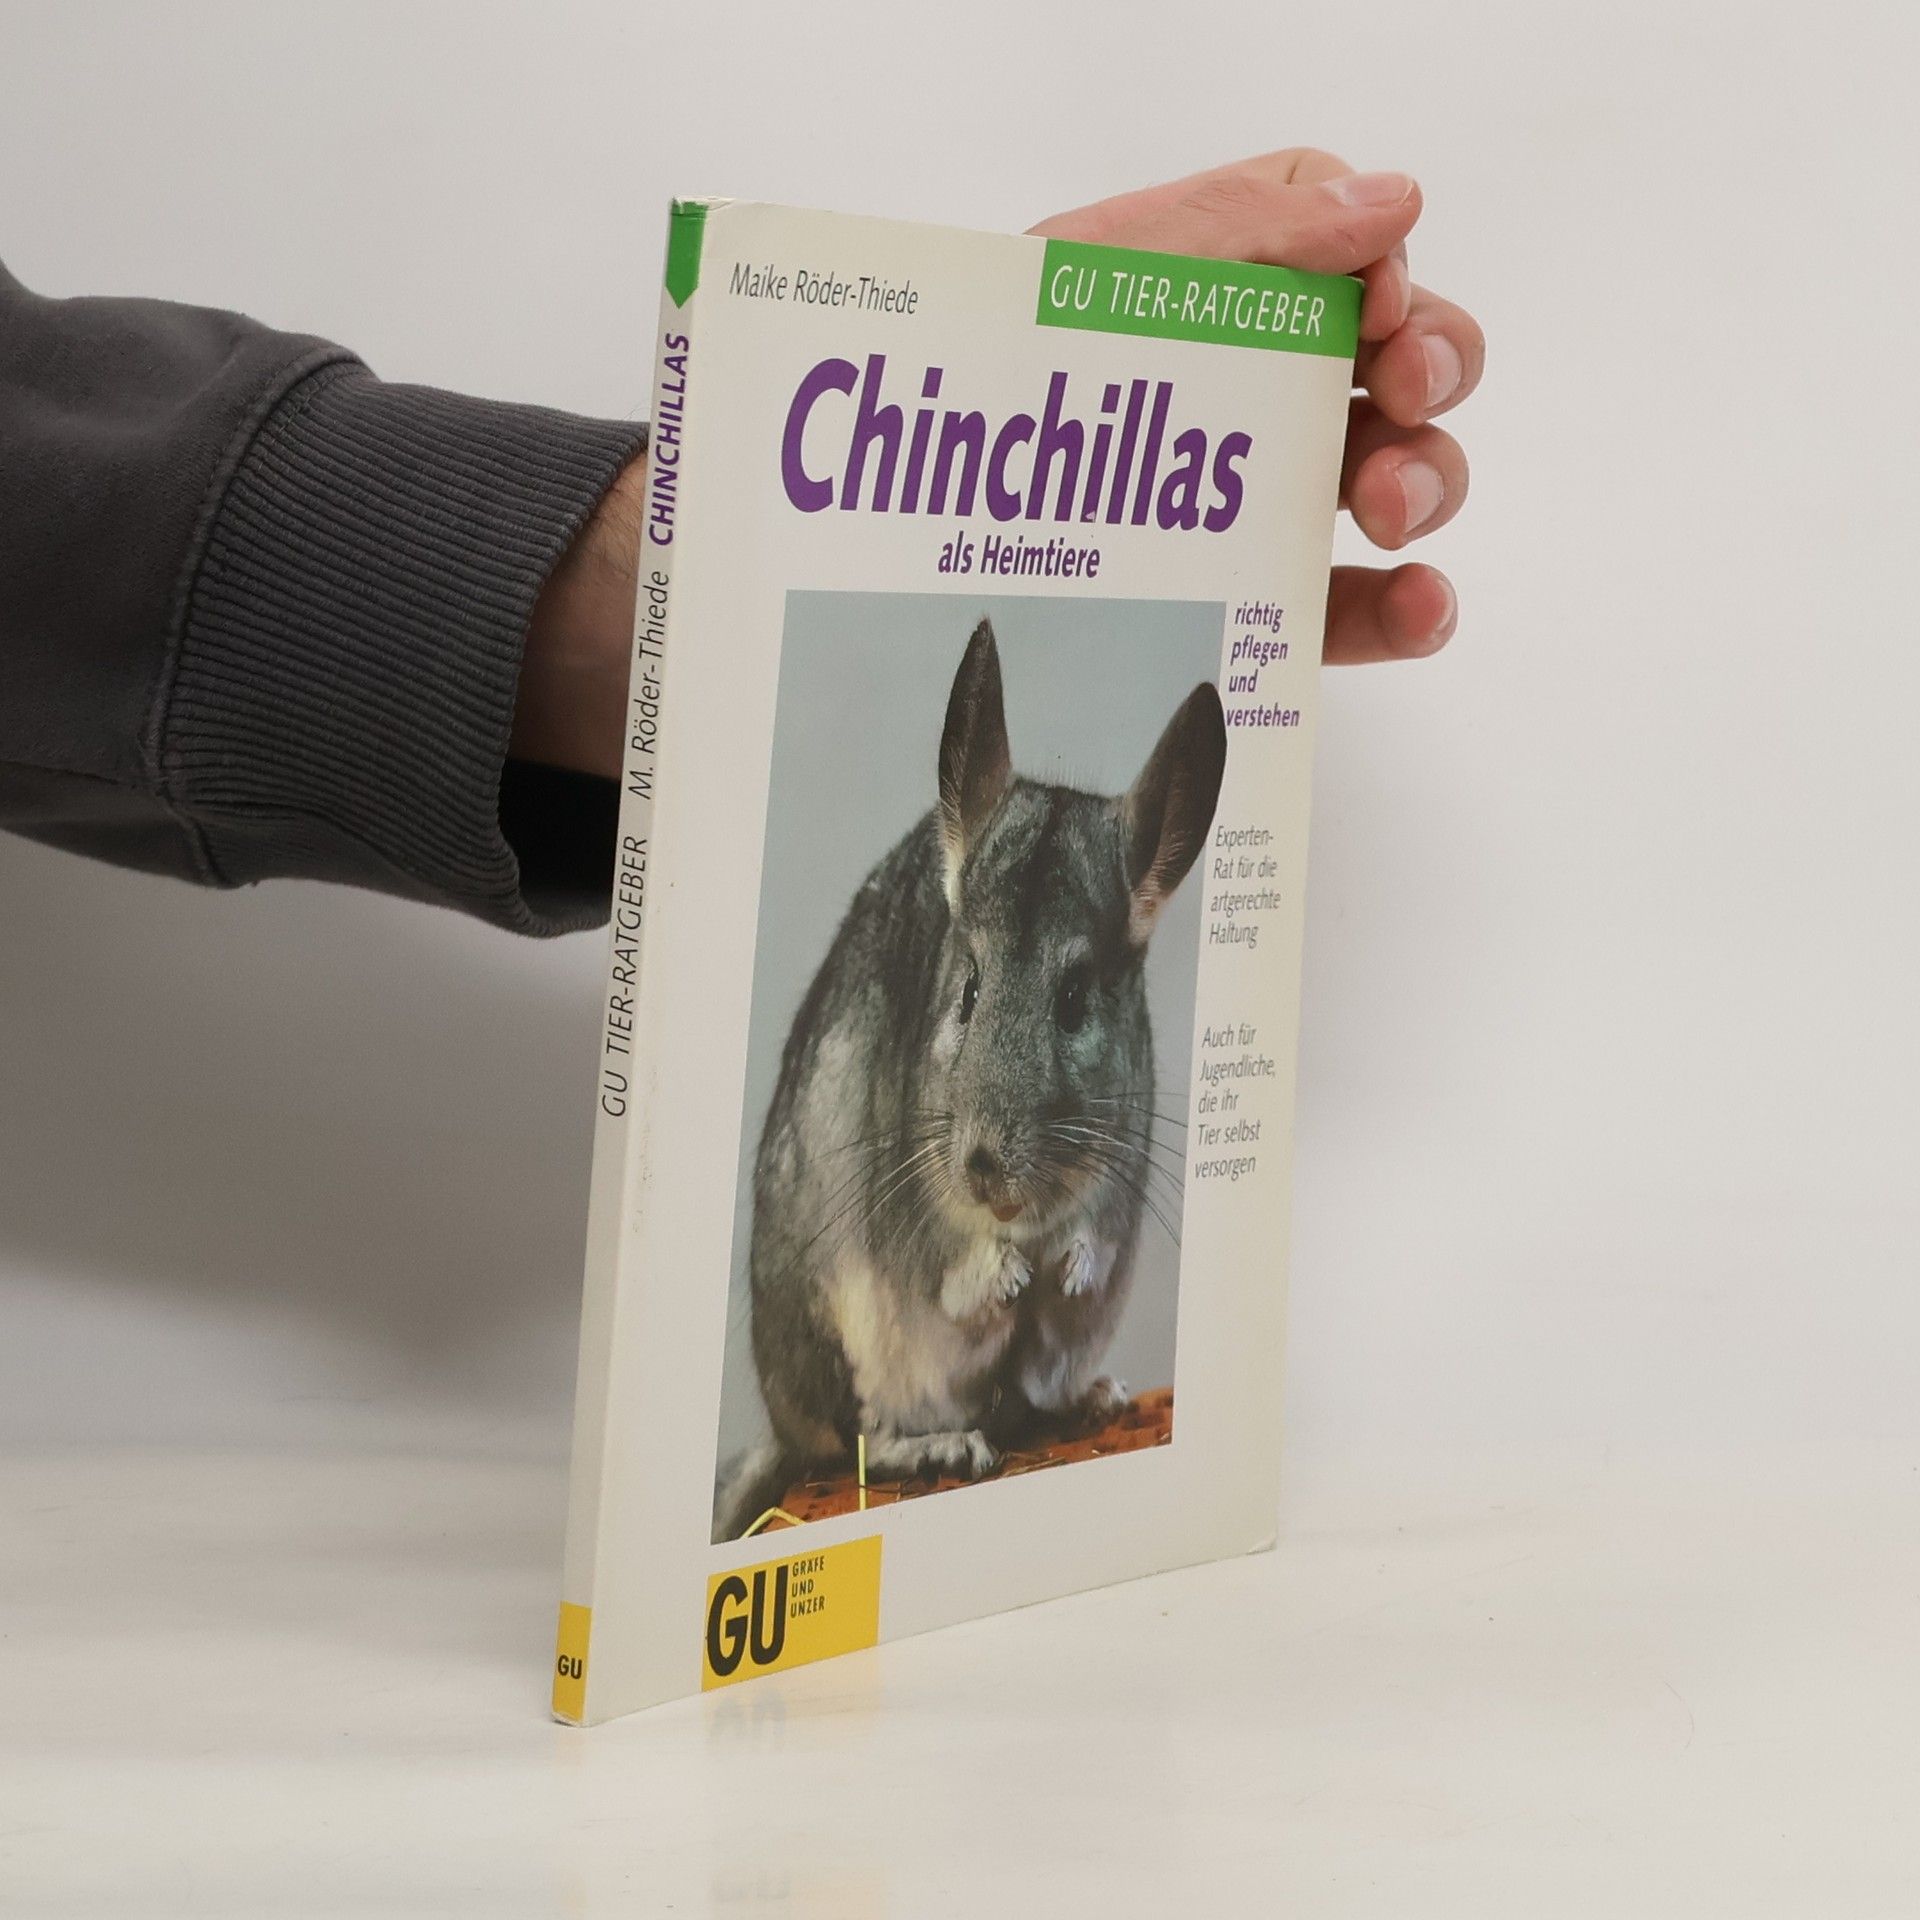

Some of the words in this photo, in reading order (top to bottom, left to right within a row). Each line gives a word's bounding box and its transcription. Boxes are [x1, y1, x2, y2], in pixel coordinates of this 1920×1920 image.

[729, 262, 788, 301] Maike
[794, 269, 919, 316] Röder-Thiede
[1050, 264, 1096, 311] GU
[1110, 271, 1326, 338] TIER-RATGEBER
[649, 332, 690, 546] CHINCHILLAS
[780, 353, 1253, 533] Chinchillas
[937, 531, 973, 575] als
[980, 536, 1101, 579] Heimtiere
[1234, 601, 1284, 634] richtig
[631, 570, 669, 754] Röder-Thiede
[1230, 634, 1288, 667] pflegen
[1228, 668, 1259, 693] und
[1226, 702, 1300, 727] verstehen
[628, 767, 654, 800] M.
[1215, 824, 1274, 853] Experten-
[1213, 857, 1234, 879] Rat
[1237, 855, 1255, 879] für
[1258, 854, 1278, 878] die
[1210, 887, 1281, 918] artgerechte
[606, 835, 648, 1055] TIER-RATGEBER
[1209, 921, 1259, 949] Haltung
[1201, 1024, 1235, 1048] Auch
[1237, 1022, 1257, 1046] für
[1199, 1054, 1276, 1087] Jugendliche,
[601, 1070, 629, 1117] GU
[1198, 1091, 1218, 1114] die
[1220, 1088, 1239, 1111] ihr
[1198, 1123, 1221, 1146] Tier
[1224, 1119, 1261, 1144] selbst
[1195, 1156, 1257, 1182] versorgen
[791, 1580, 814, 1598] UND
[707, 1564, 789, 1677] GU
[790, 1595, 825, 1619] UNZER
[557, 1654, 583, 1680] GU
